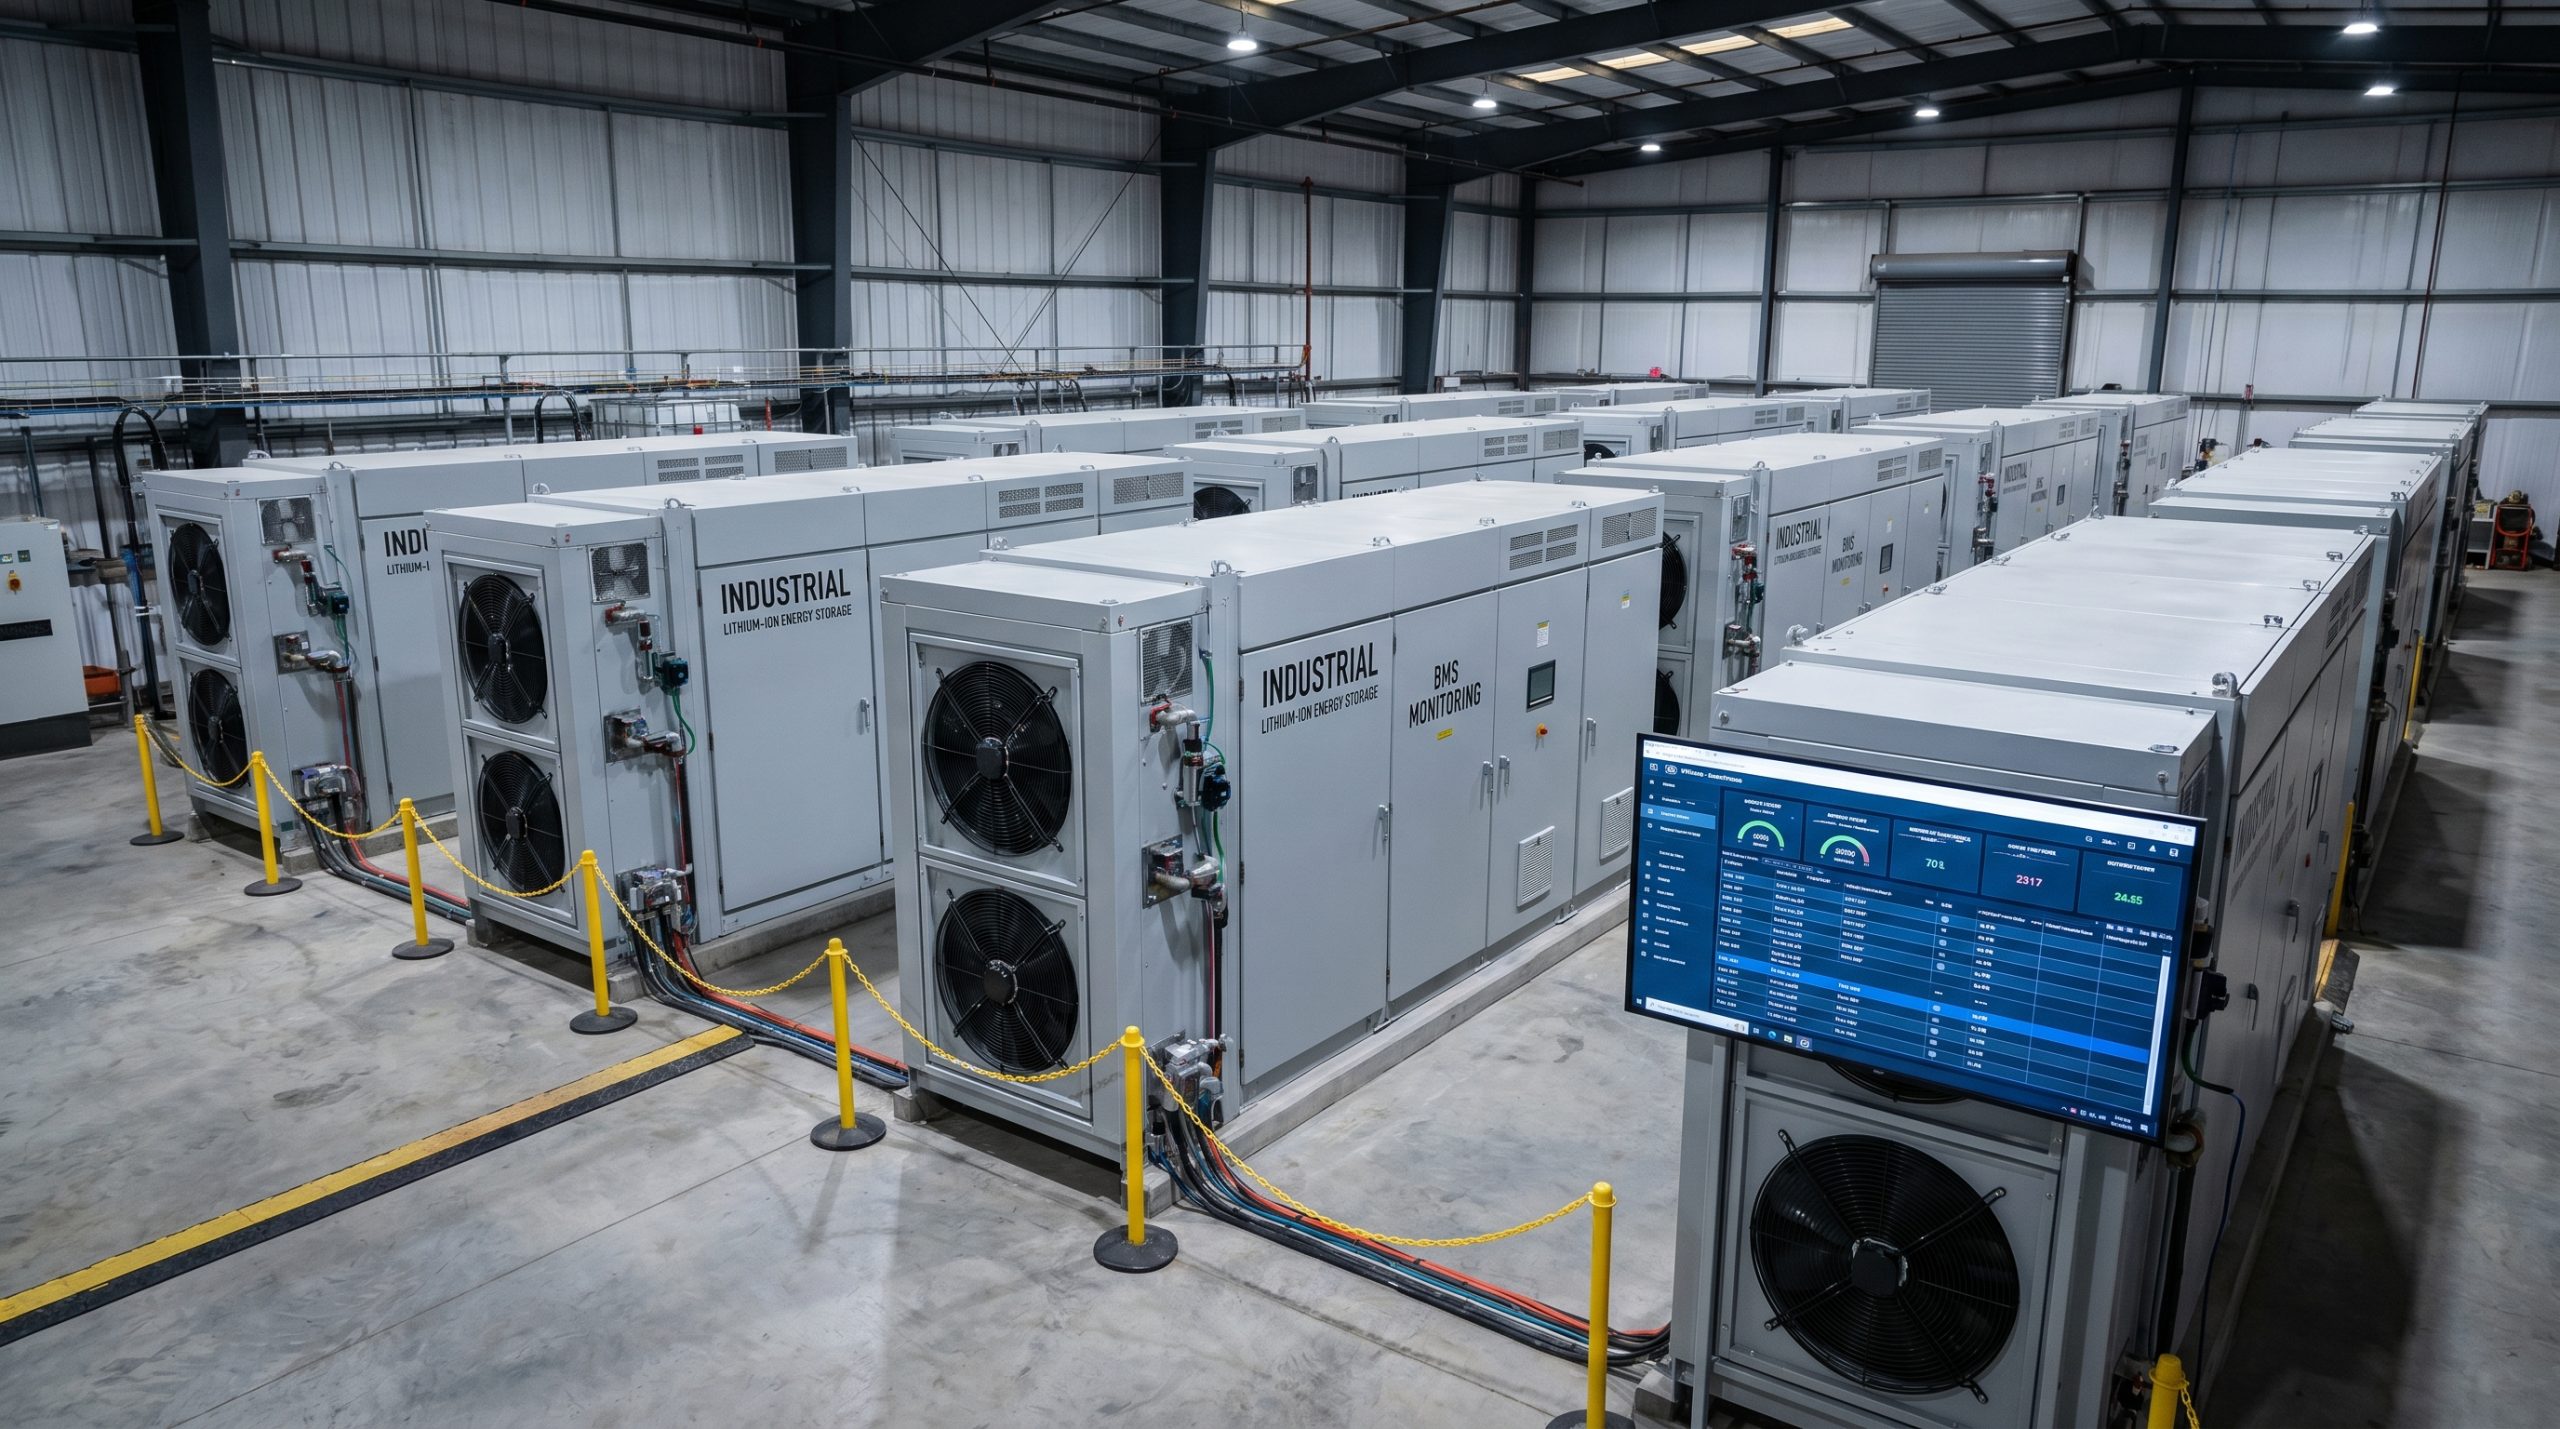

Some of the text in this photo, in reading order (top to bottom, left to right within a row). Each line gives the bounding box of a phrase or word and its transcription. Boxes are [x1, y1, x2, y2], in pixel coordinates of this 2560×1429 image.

[1776, 518, 1822, 550] INDUSTRIAL
[721, 569, 851, 614] INDUSTRIAL
[724, 604, 852, 635] LITHIUM-ION ENERGY STORAGE
[1263, 642, 1378, 708] INDUSTRIAL
[1434, 660, 1459, 690] BMS
[1262, 685, 1378, 734] LITHIUM-ION ENERGY STORAGE
[1409, 682, 1481, 728] MONITORING
[2016, 875, 2043, 887] 2317
